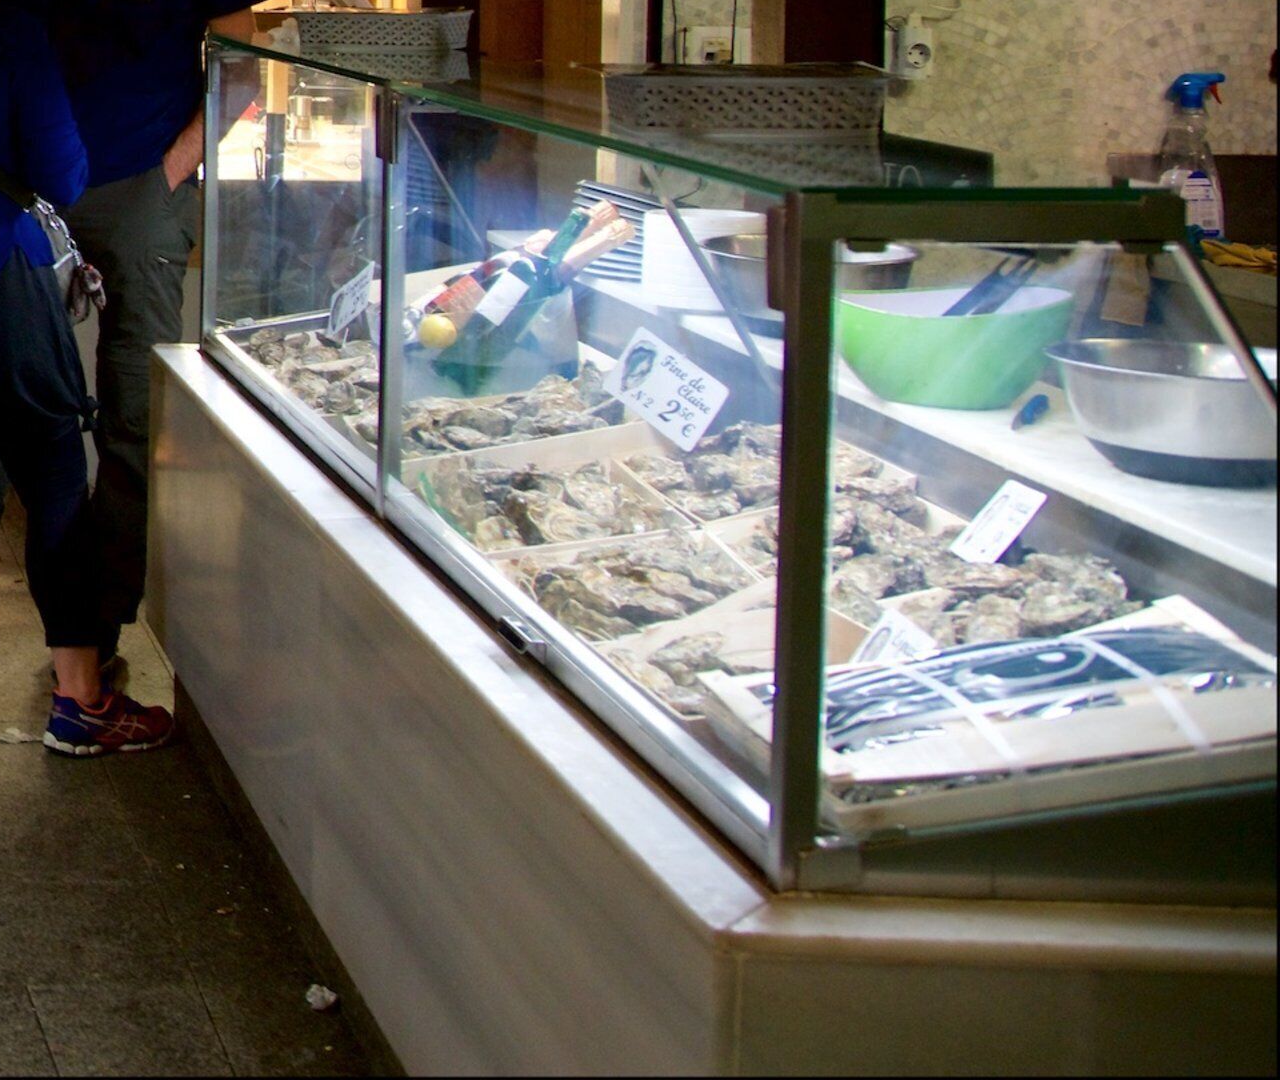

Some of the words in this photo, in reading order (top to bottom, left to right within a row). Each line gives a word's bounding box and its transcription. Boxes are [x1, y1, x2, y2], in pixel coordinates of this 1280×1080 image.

[660, 354, 689, 382] Fine
[688, 376, 706, 394] de
[657, 398, 682, 423] 2
[681, 422, 697, 439] €
[677, 384, 712, 415] Claire
